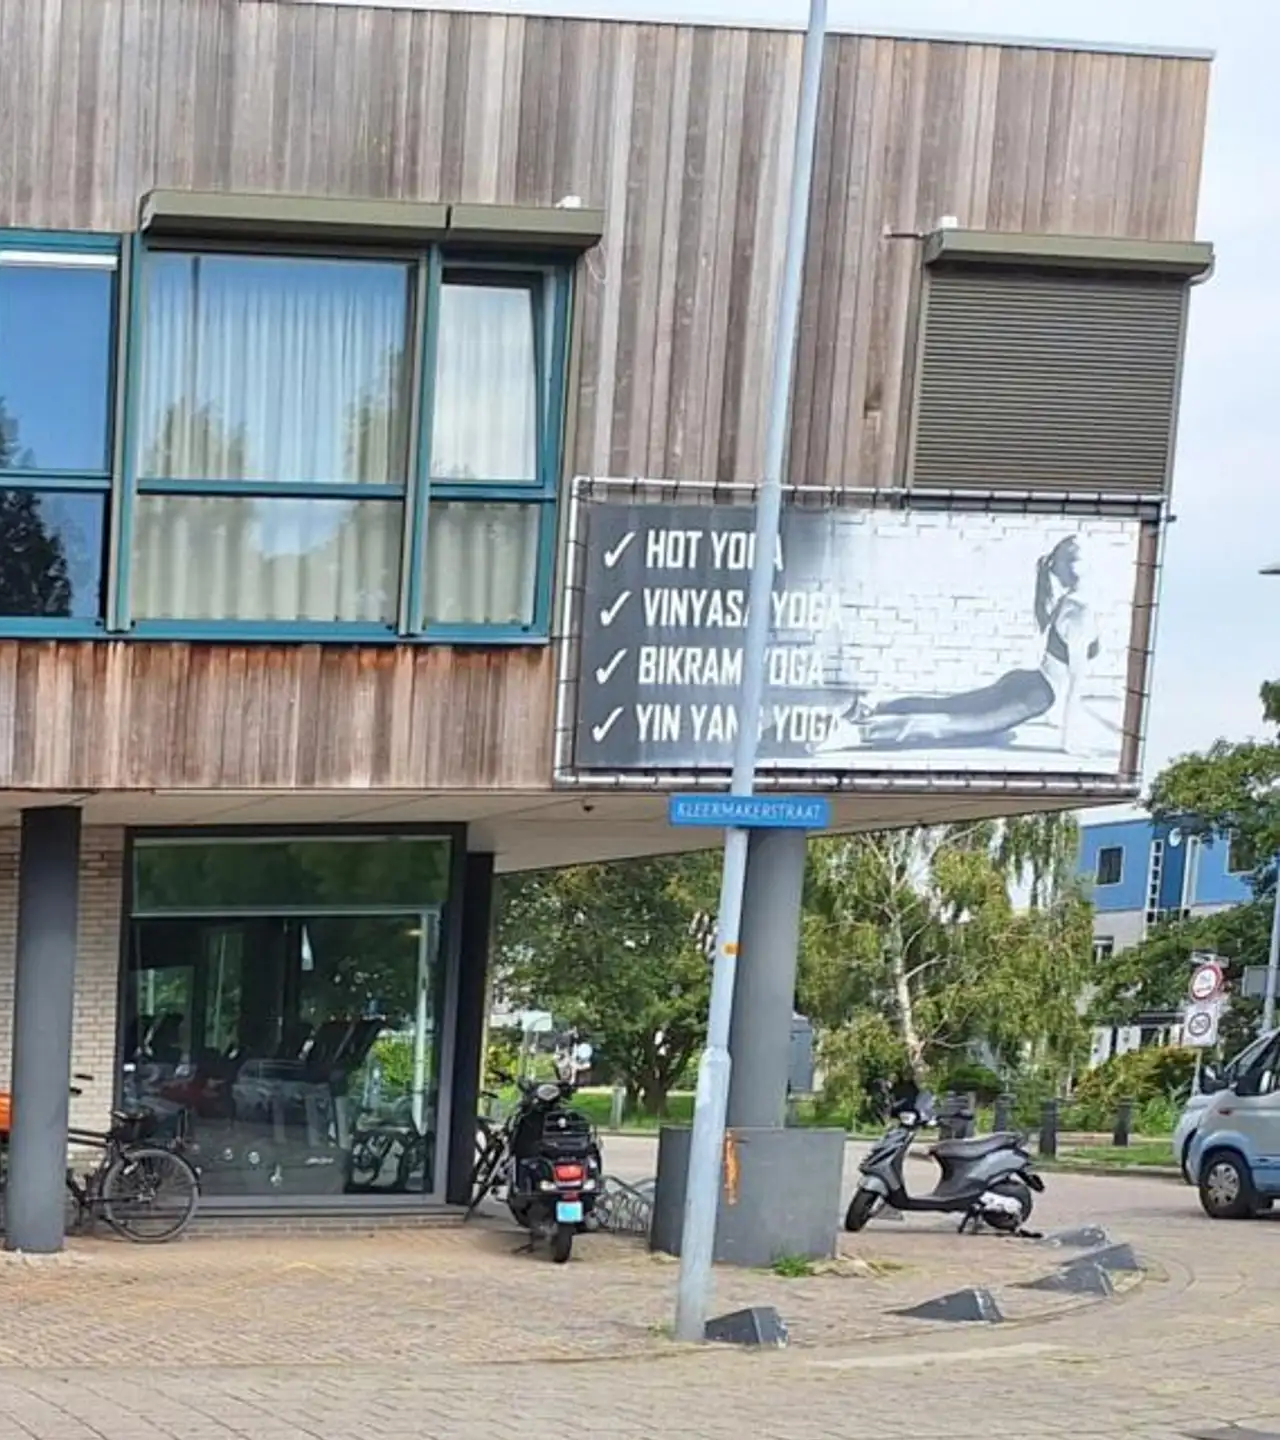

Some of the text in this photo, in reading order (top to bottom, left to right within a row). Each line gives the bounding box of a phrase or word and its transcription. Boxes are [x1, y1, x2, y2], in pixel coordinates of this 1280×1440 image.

[646, 529, 703, 569] HOT
[643, 588, 842, 629] VINYAS YOGA
[638, 647, 825, 686] BIKRAM OGA
[636, 705, 681, 742] YIN
[676, 801, 822, 821] KLEERMAKERSTRAAT
